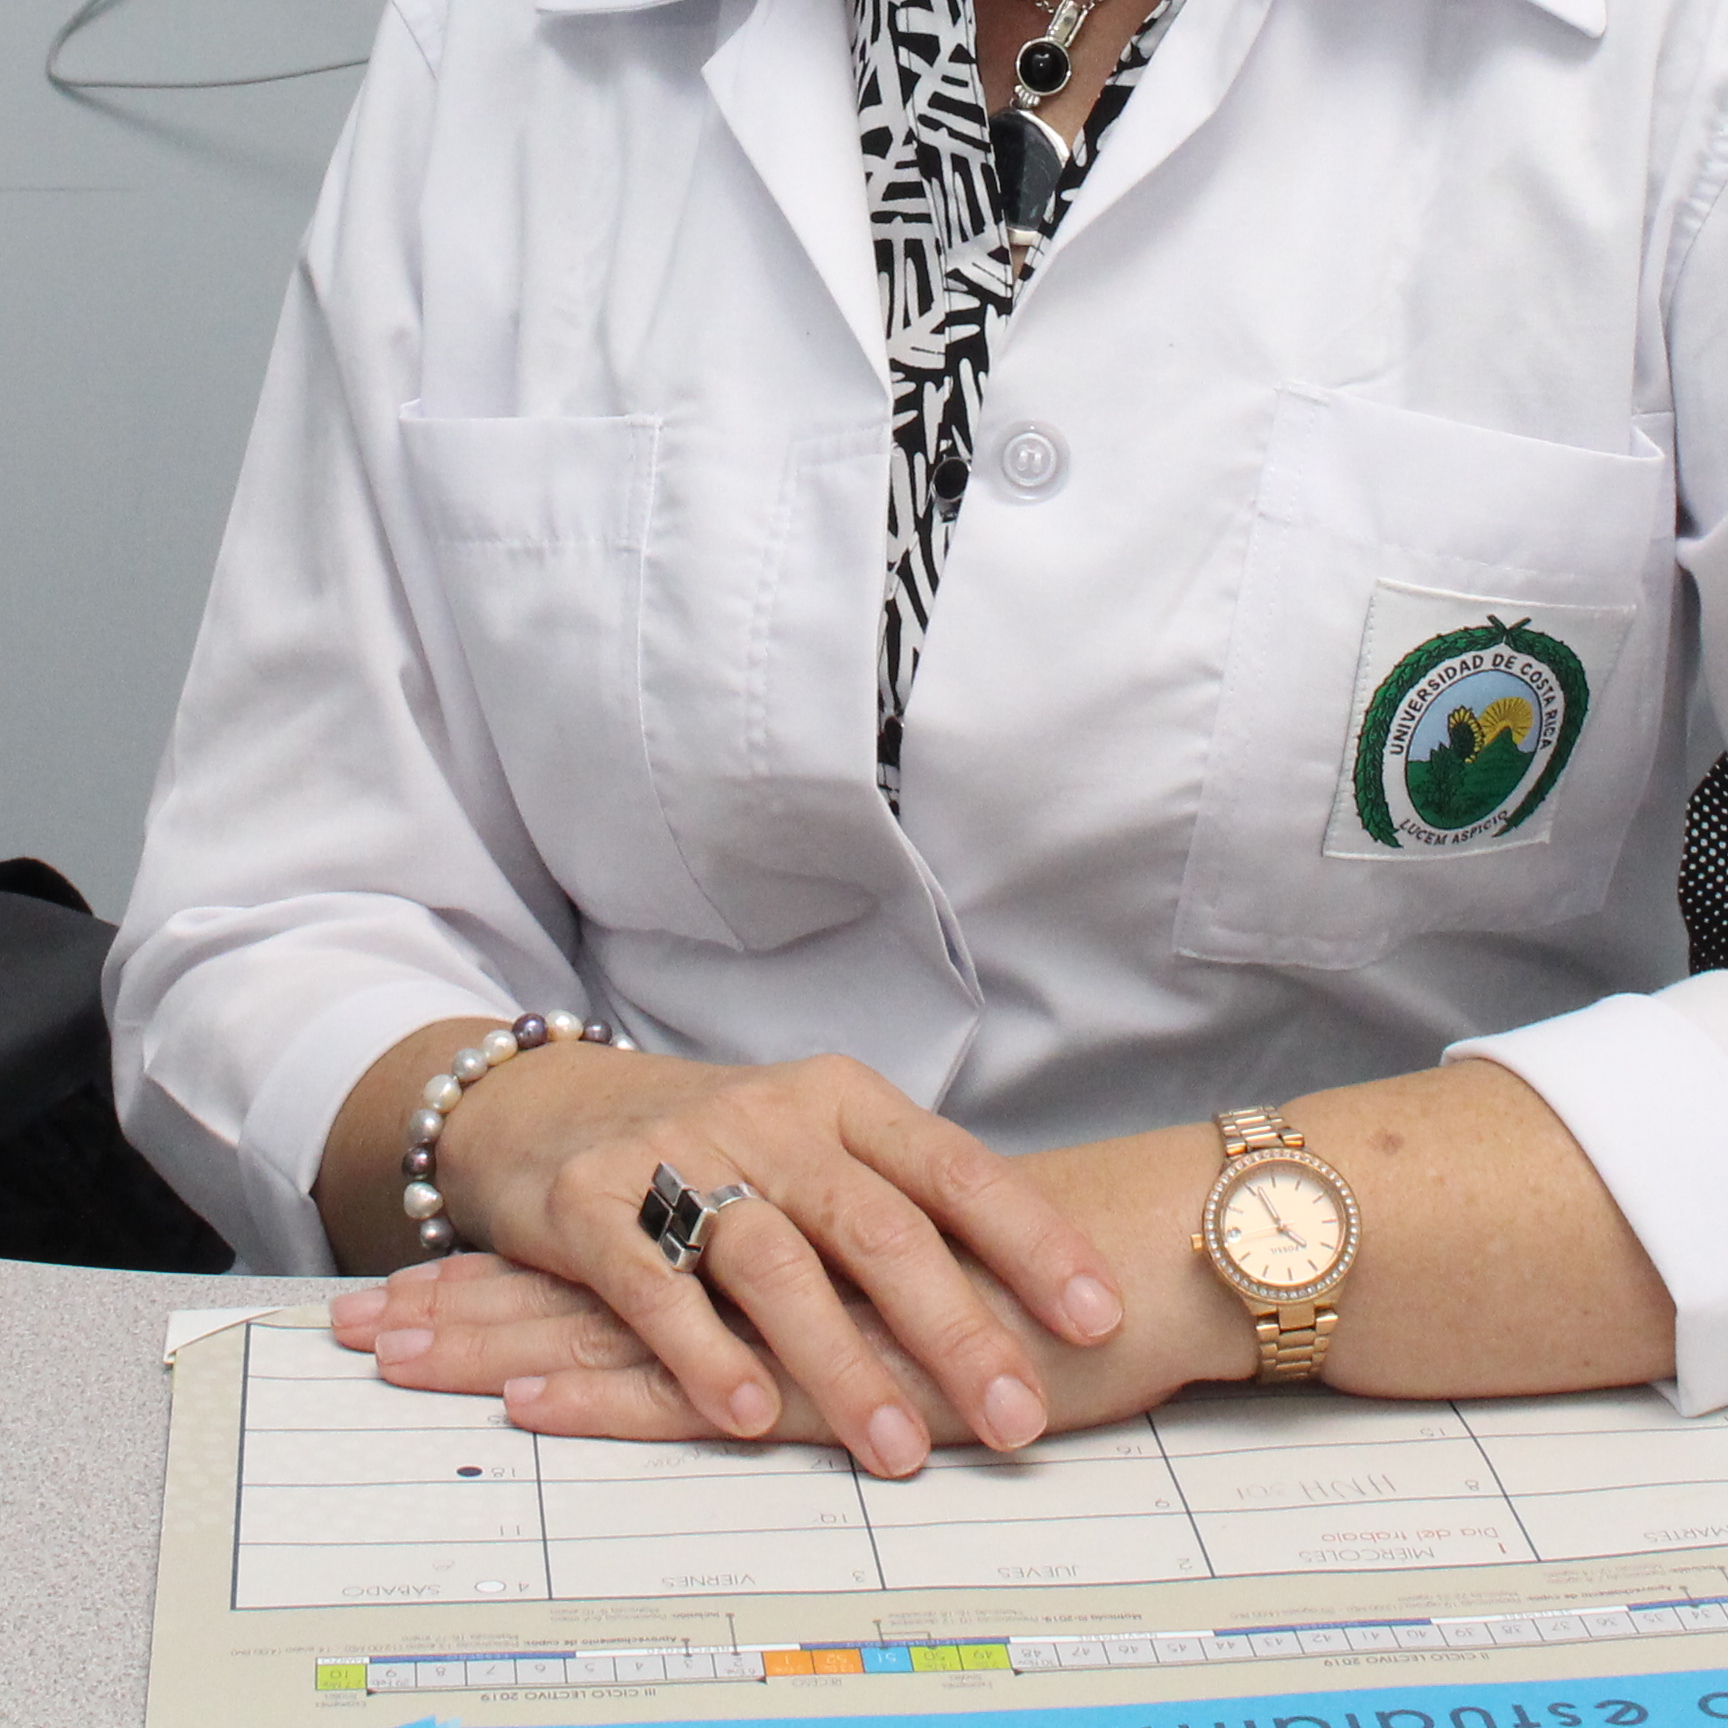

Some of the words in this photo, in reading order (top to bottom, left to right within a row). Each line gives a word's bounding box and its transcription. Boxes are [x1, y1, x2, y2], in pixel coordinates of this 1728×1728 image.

[1389, 654, 1485, 756] UNIVERSIDAD
[1491, 654, 1517, 670] DE
[1520, 662, 1555, 707] COSTA
[1540, 710, 1557, 751] RICA
[1399, 818, 1448, 846] LUCEM
[1451, 810, 1509, 844] ASPICIO
[1270, 1245, 1300, 1255] FOSSIL
[1420, 1428, 1446, 1438] 15
[1116, 1445, 1143, 1455] 16
[811, 1459, 834, 1469] 17
[491, 1467, 516, 1478] 18
[1464, 1479, 1479, 1492] 8
[1155, 1498, 1170, 1508] 9
[499, 1525, 521, 1536] 11
[1415, 1529, 1451, 1542] del
[1320, 1529, 1406, 1545] trabajo
[1298, 1547, 1434, 1564] MIÉRCOLES
[1177, 1558, 1192, 1570] 2
[852, 1571, 865, 1582] 3
[997, 1565, 1079, 1578] JUEVES
[661, 1573, 756, 1588] VIERNES
[341, 1584, 441, 1599] SÁBADO
[517, 1582, 530, 1593] 4
[1643, 1612, 1665, 1624] 35
[1691, 1609, 1711, 1621] 34
[1552, 1620, 1571, 1631] 37
[1596, 1617, 1619, 1628] 36
[1361, 1631, 1380, 1641] 41
[1406, 1629, 1428, 1639] 40
[1454, 1627, 1475, 1638] 39
[1501, 1625, 1524, 1636] 38
[1264, 1636, 1284, 1647] 43
[1311, 1633, 1332, 1644] 42
[1118, 1644, 1139, 1655] 46
[1166, 1642, 1187, 1653] 45
[1214, 1640, 1236, 1651] 44
[923, 1650, 946, 1661] 50
[973, 1649, 994, 1660] 49
[1021, 1647, 1042, 1659] 48
[1071, 1646, 1091, 1657] 47
[1430, 1652, 1476, 1662] CICLO
[826, 1653, 848, 1664] 52
[876, 1652, 897, 1663] 51
[1323, 1658, 1360, 1667] 2019
[1365, 1653, 1426, 1664] LECTIVO
[535, 1663, 546, 1674] 6
[584, 1663, 595, 1673] 5
[634, 1661, 643, 1671] 4
[683, 1659, 693, 1669] 3
[329, 1669, 349, 1680] 10
[385, 1668, 396, 1679] 9
[435, 1666, 446, 1677] 8
[486, 1665, 496, 1676] 7
[792, 1678, 842, 1687] RECESO
[480, 1692, 519, 1701] 2019
[523, 1690, 587, 1700] LECTIVO
[590, 1689, 640, 1698] CICLO
